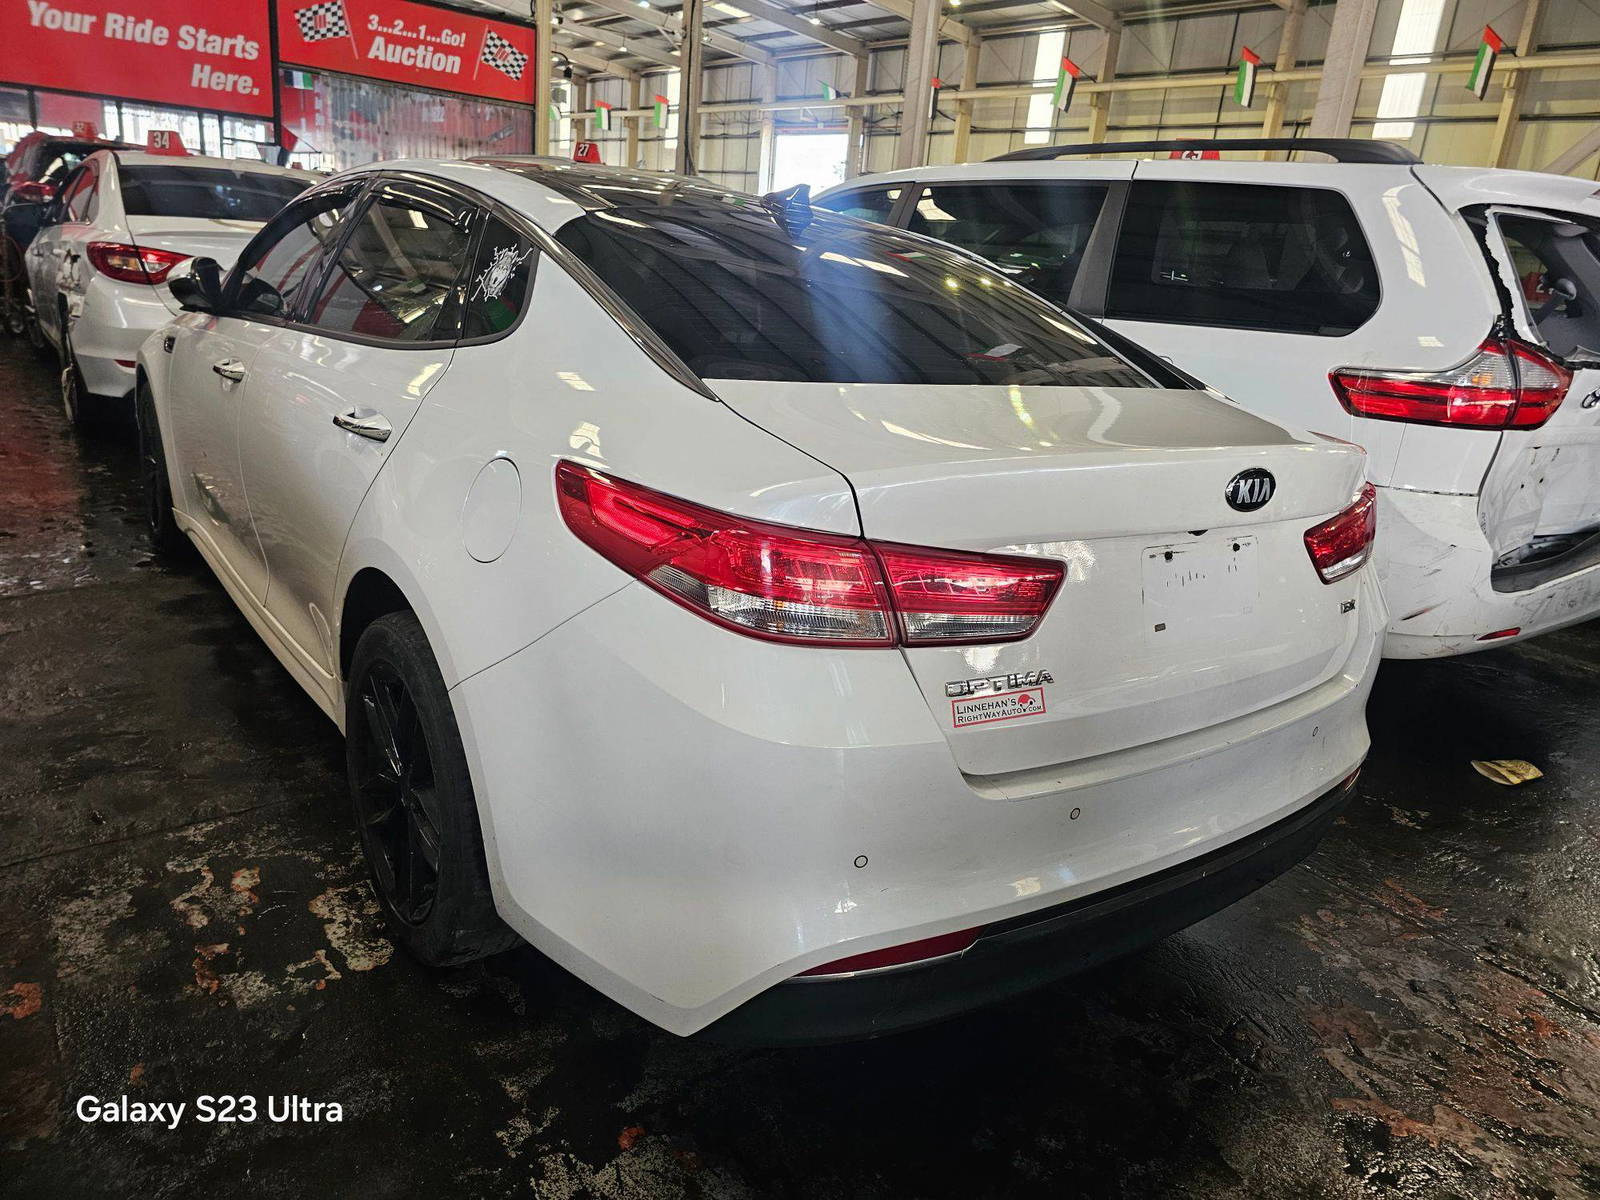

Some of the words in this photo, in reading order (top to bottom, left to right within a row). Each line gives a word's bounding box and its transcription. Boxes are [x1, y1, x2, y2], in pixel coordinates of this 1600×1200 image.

[27, 0, 97, 35] Your
[104, 12, 169, 46] Ride
[177, 24, 259, 60] Starts
[367, 14, 467, 48] 3...2...1...Go!
[367, 36, 462, 74] Auction
[191, 63, 260, 96] Here.
[153, 131, 170, 149] 34
[577, 143, 590, 157] 27
[1236, 477, 1271, 504] KIA
[945, 669, 1055, 697] OPTIMA
[956, 698, 1017, 715] LINNEHAN'S
